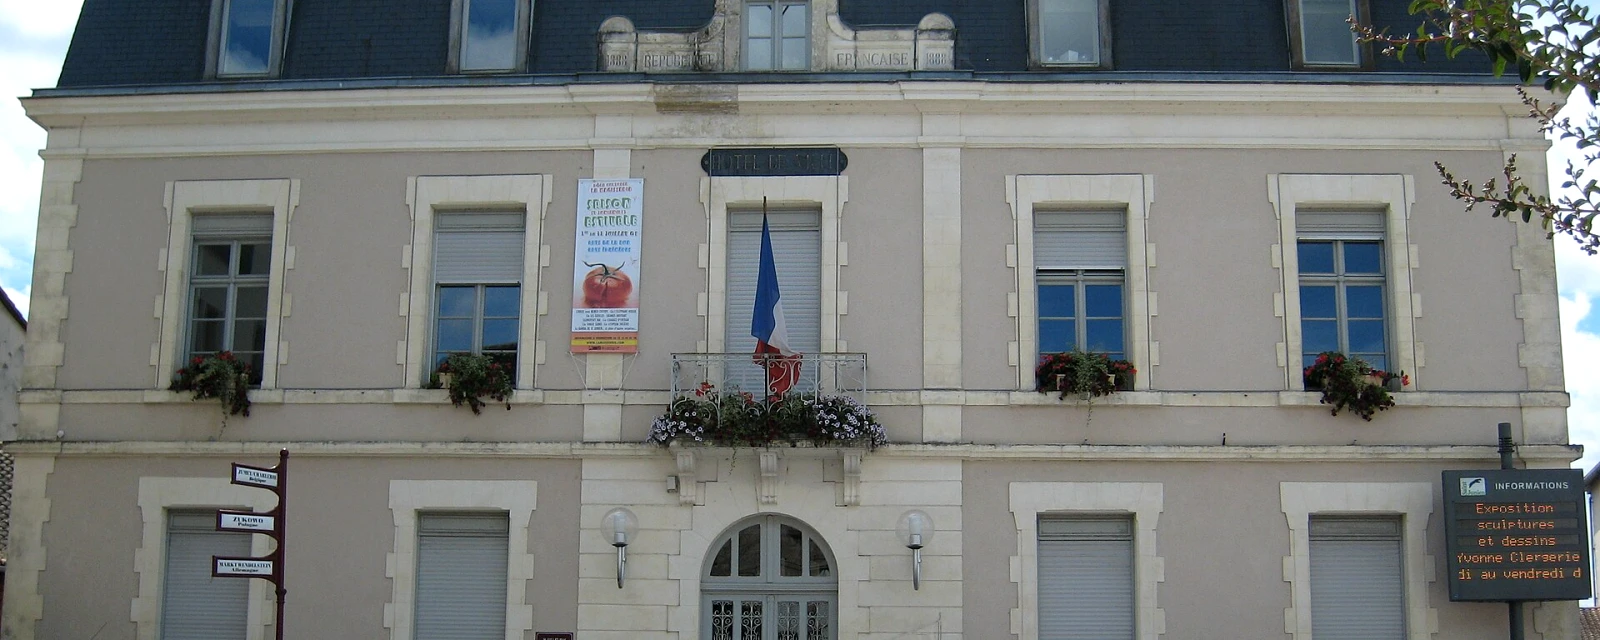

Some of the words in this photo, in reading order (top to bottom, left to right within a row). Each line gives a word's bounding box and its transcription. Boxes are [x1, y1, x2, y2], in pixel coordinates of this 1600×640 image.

[925, 52, 948, 66] 1888
[587, 198, 631, 210] SAISON
[584, 215, 637, 227] ESTIVALE
[1495, 482, 1569, 490] INFORMATIONS
[1476, 503, 1554, 513] Exposition
[1477, 519, 1555, 529] sculptures
[1478, 537, 1494, 546] et
[1501, 535, 1557, 546] dessins
[1457, 553, 1503, 563] Yvonne
[1481, 571, 1496, 579] au
[1503, 568, 1564, 578] vendredi
[1573, 567, 1581, 577] d
